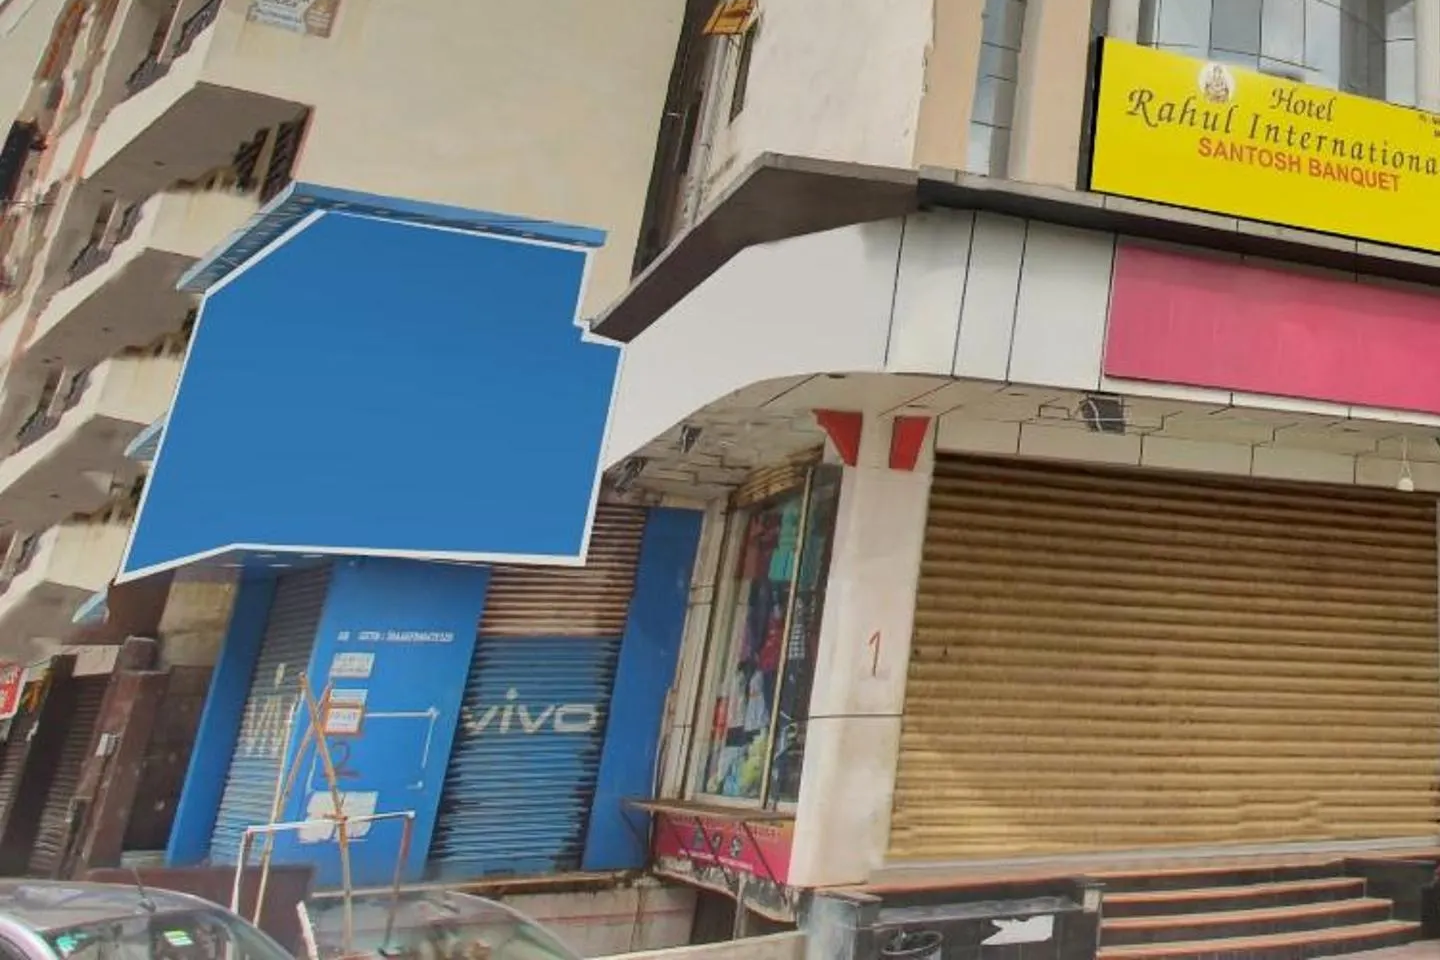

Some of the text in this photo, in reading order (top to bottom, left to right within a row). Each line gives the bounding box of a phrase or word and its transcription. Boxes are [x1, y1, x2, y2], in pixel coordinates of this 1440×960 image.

[1126, 87, 1239, 134] Rahul
[1269, 86, 1337, 122] Hotel
[1197, 136, 1401, 193] SANTOSH BANQUET
[463, 687, 598, 734] vivo
